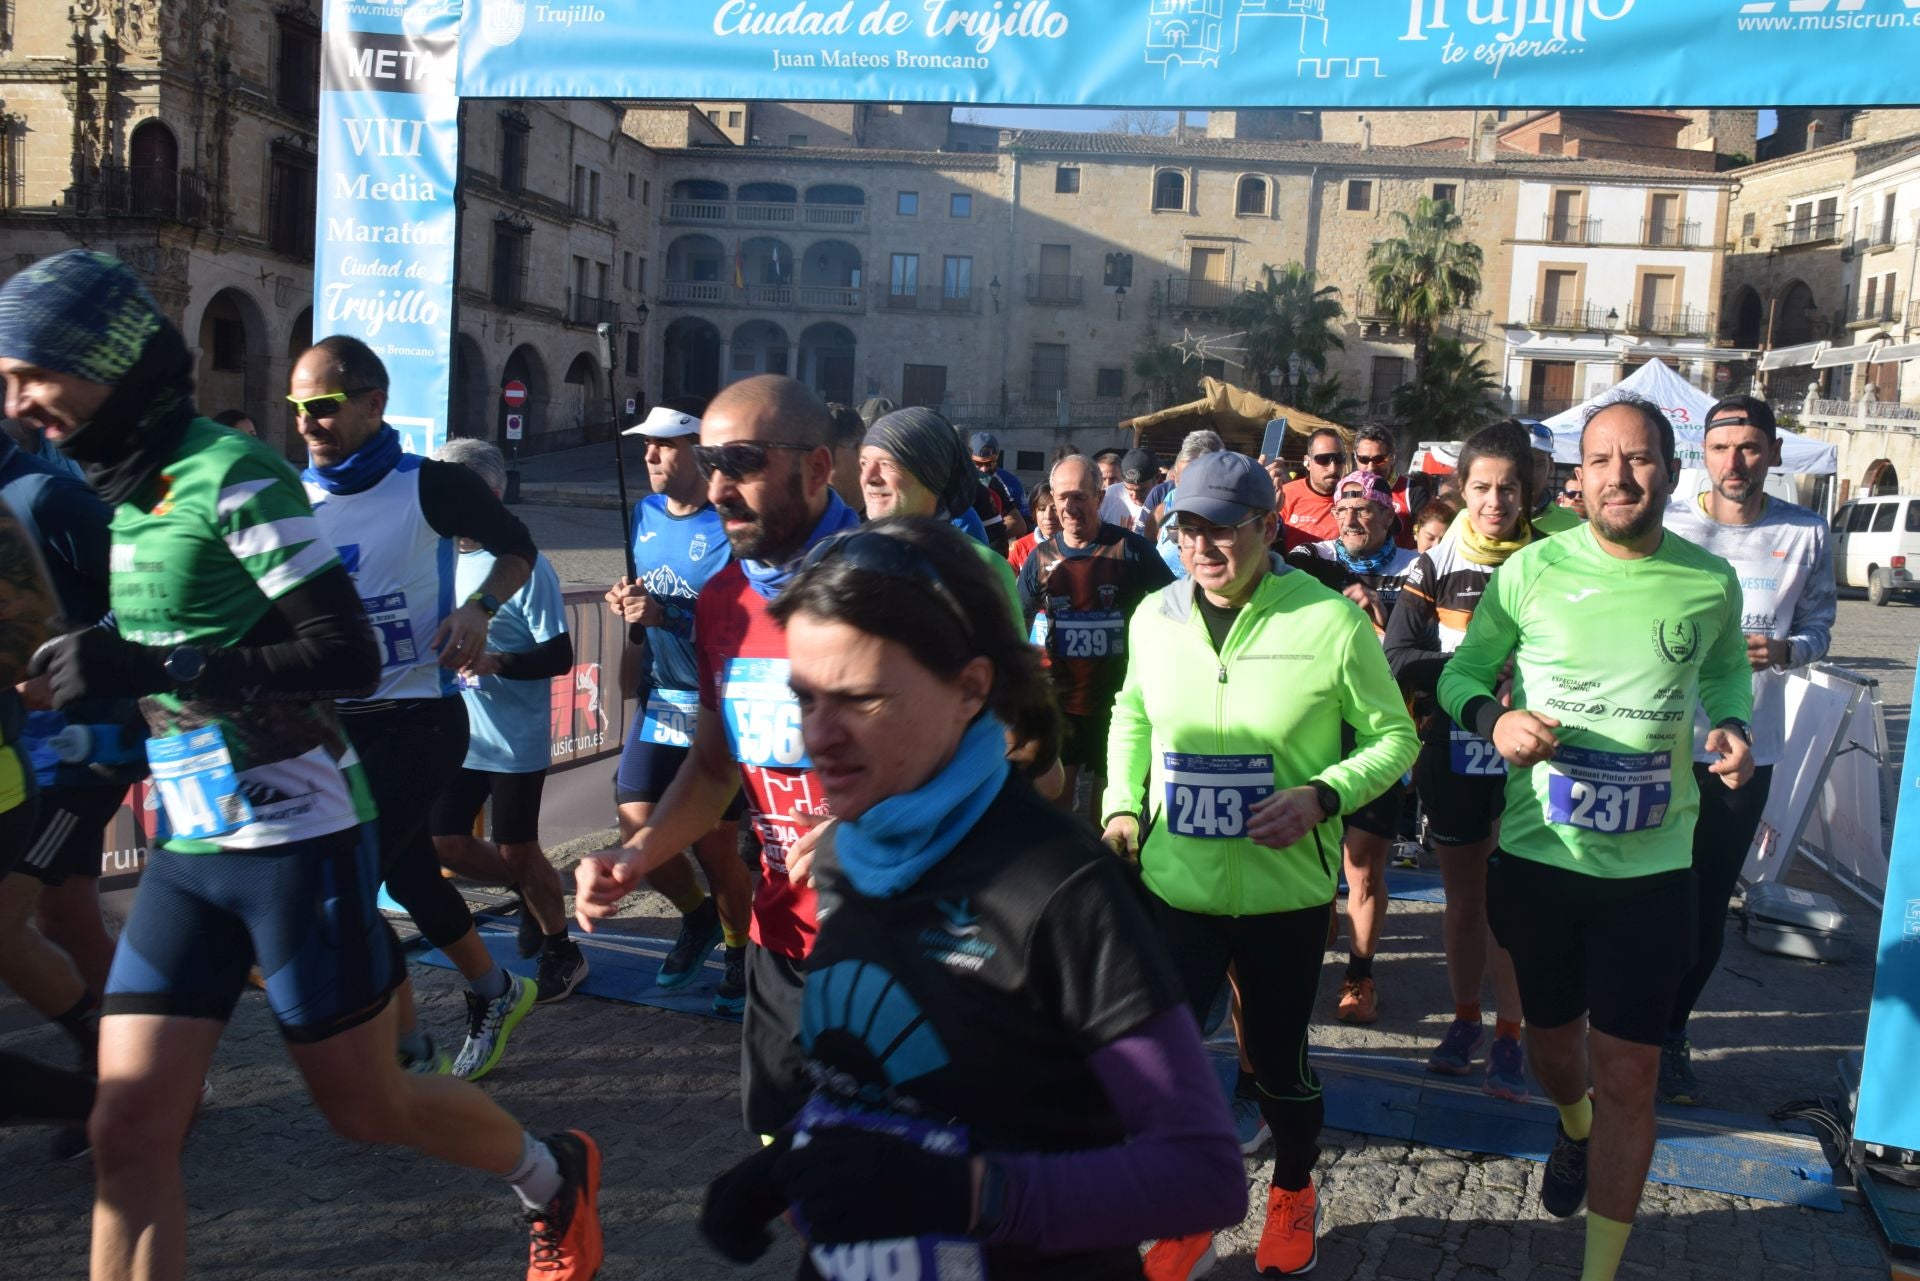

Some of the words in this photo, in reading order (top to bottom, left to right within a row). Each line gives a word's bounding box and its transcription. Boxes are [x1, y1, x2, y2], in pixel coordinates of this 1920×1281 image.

[535, 5, 606, 28] Trujillo
[712, 0, 855, 38] Ciudad
[858, 1, 912, 37] de
[923, 0, 1070, 54] Trujillo
[348, 47, 438, 81] META
[772, 49, 816, 71] Juan
[820, 50, 890, 68] Mateos
[896, 50, 989, 69] Broncano
[1441, 32, 1470, 64] te
[1473, 37, 1586, 79] espera...
[343, 118, 428, 157] VIII
[333, 172, 437, 202] Media
[326, 216, 449, 246] Maratón
[339, 255, 403, 278] Ciudad
[404, 260, 428, 279] de
[324, 282, 439, 337] Trujillo
[387, 344, 435, 358] Broncano
[1065, 628, 1108, 658] 239
[1544, 697, 1586, 713] PACO
[1611, 707, 1685, 722] MODESTO
[1464, 740, 1509, 775] 22
[1570, 767, 1601, 781] Manuel
[1601, 770, 1626, 782] Pintor
[1175, 785, 1244, 837] 243
[1569, 780, 1641, 832] 231
